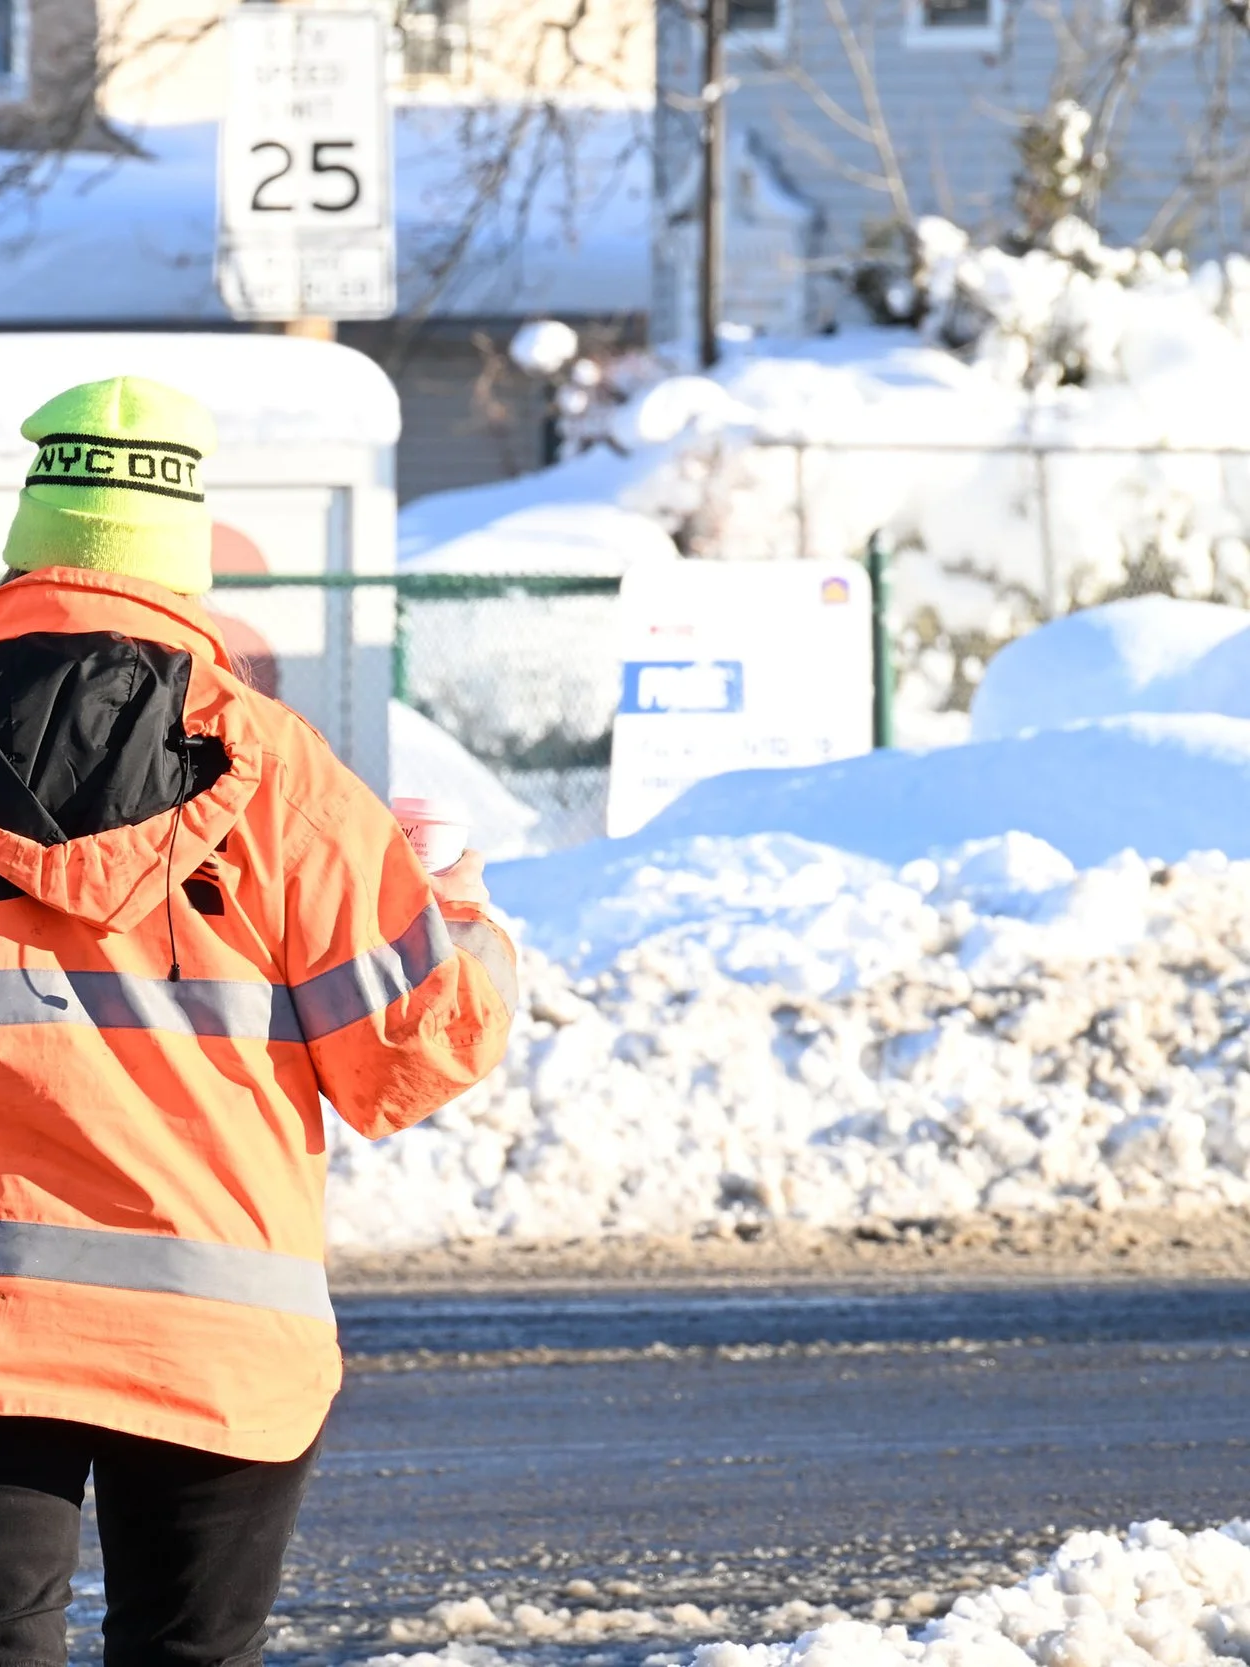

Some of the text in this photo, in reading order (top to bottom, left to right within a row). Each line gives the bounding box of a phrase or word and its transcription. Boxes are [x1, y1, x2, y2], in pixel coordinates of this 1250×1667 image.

[250, 140, 361, 212] 25
[36, 446, 197, 488] NYC DOT
